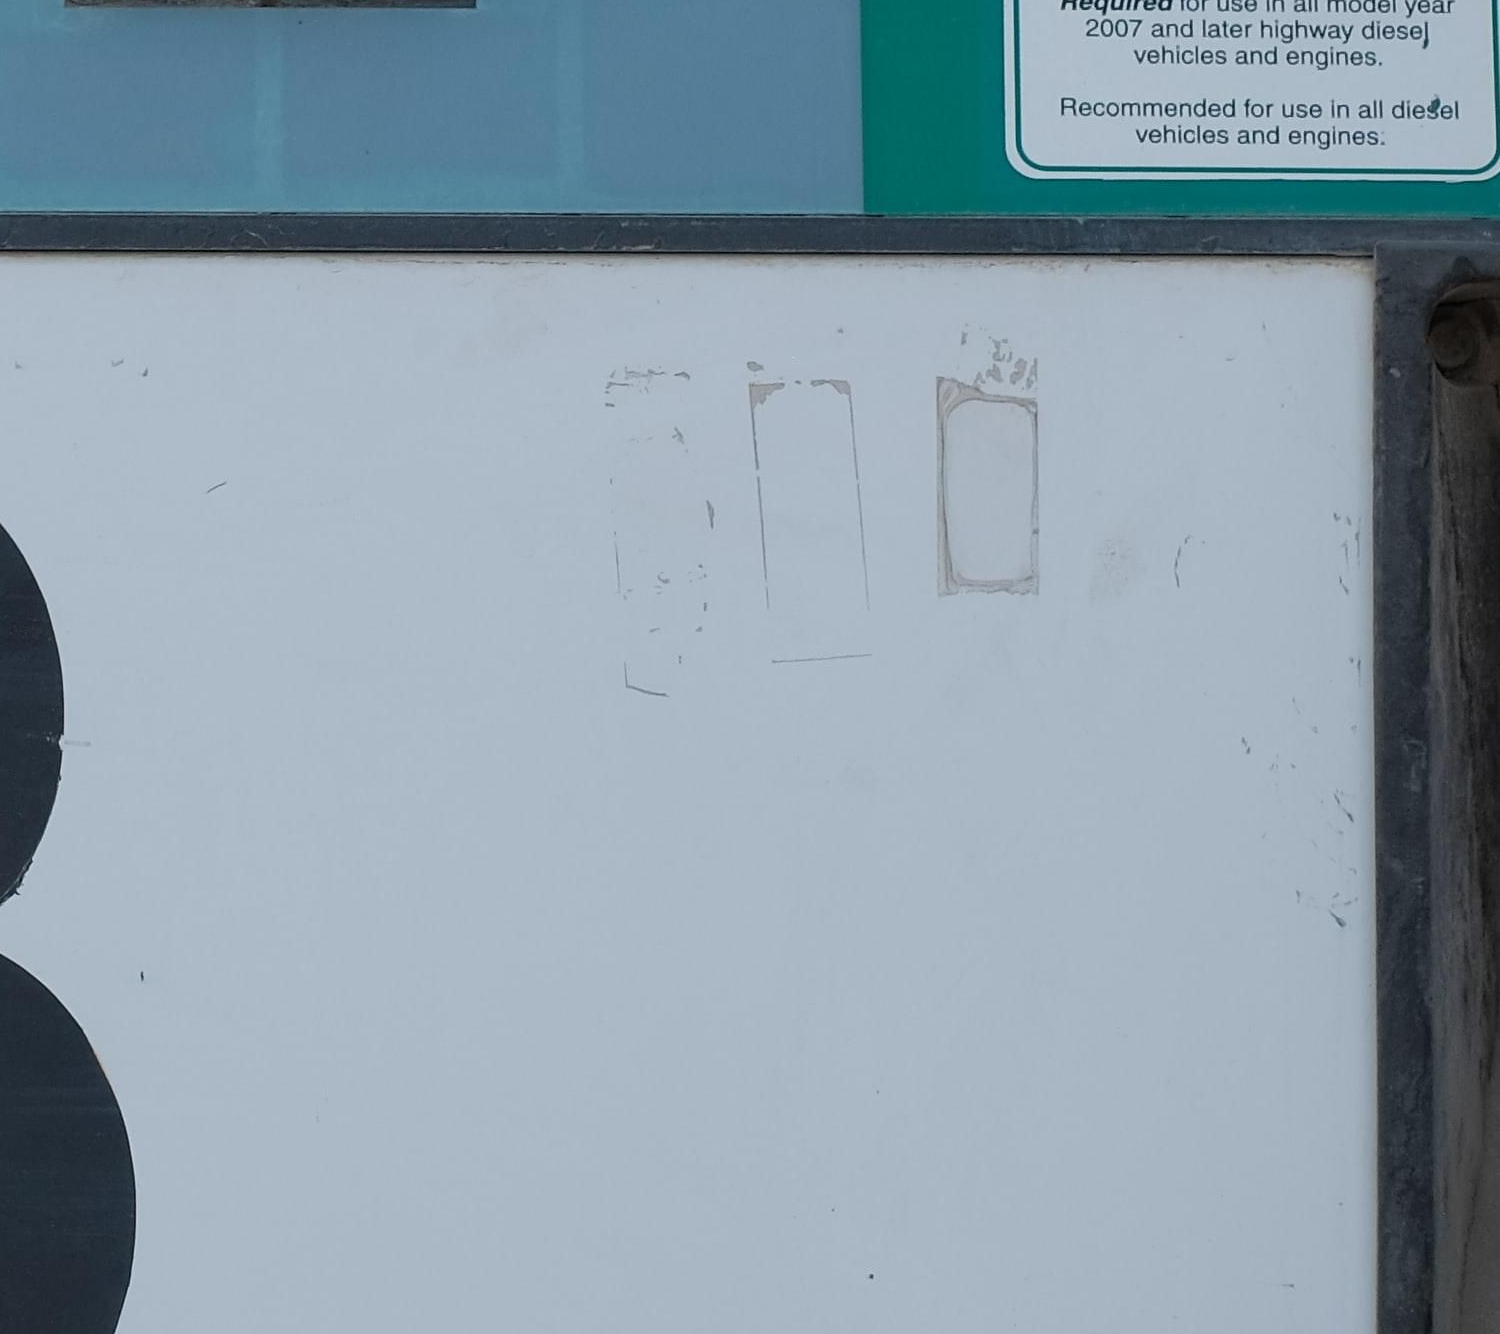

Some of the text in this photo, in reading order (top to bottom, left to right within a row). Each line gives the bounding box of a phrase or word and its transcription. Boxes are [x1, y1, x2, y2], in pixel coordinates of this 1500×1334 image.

[1085, 19, 1429, 44] 2007 and later highway diesel
[1134, 46, 1383, 70] vehicles and engines.
[1060, 97, 1459, 120] Recommended for use in all diesel
[1136, 125, 1385, 149] vehicles and engines.
